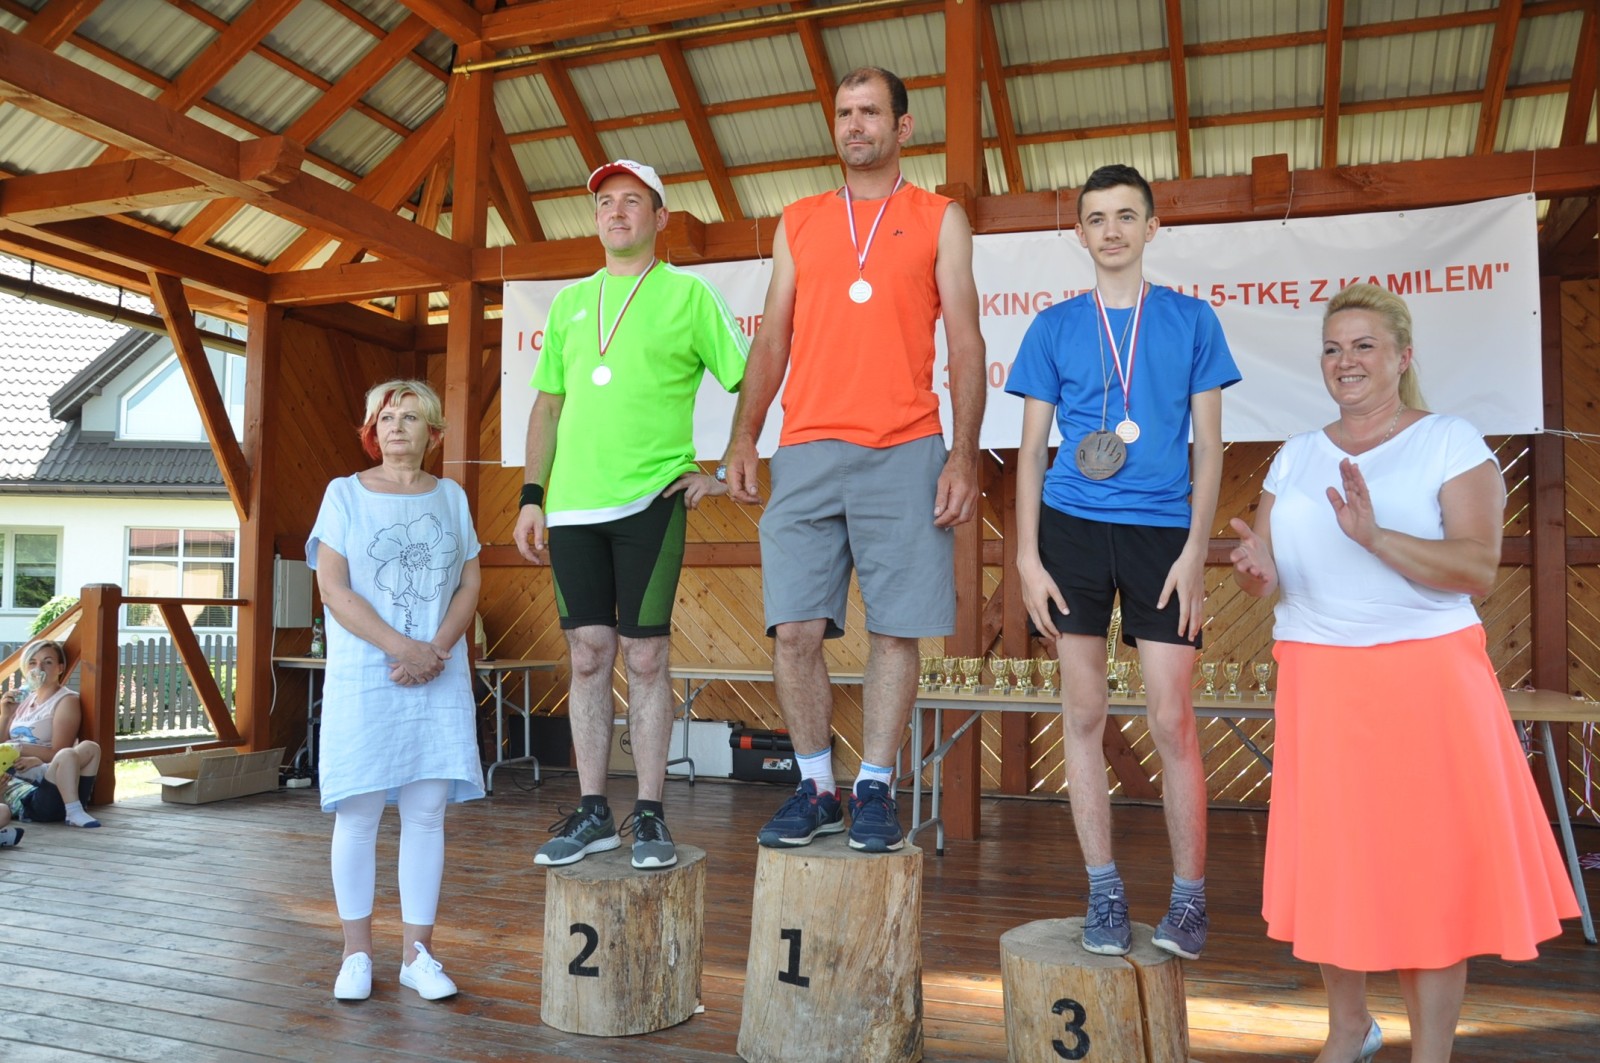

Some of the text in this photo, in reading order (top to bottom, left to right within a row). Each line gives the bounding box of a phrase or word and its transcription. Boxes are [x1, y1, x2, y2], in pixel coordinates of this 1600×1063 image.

[518, 331, 524, 351] I
[982, 290, 1053, 317] KING
[1210, 281, 1300, 310] 5-TKĘ
[1309, 279, 1329, 303] Z
[568, 922, 599, 977] 2
[778, 928, 810, 988] 1
[1051, 998, 1091, 1060] 3
